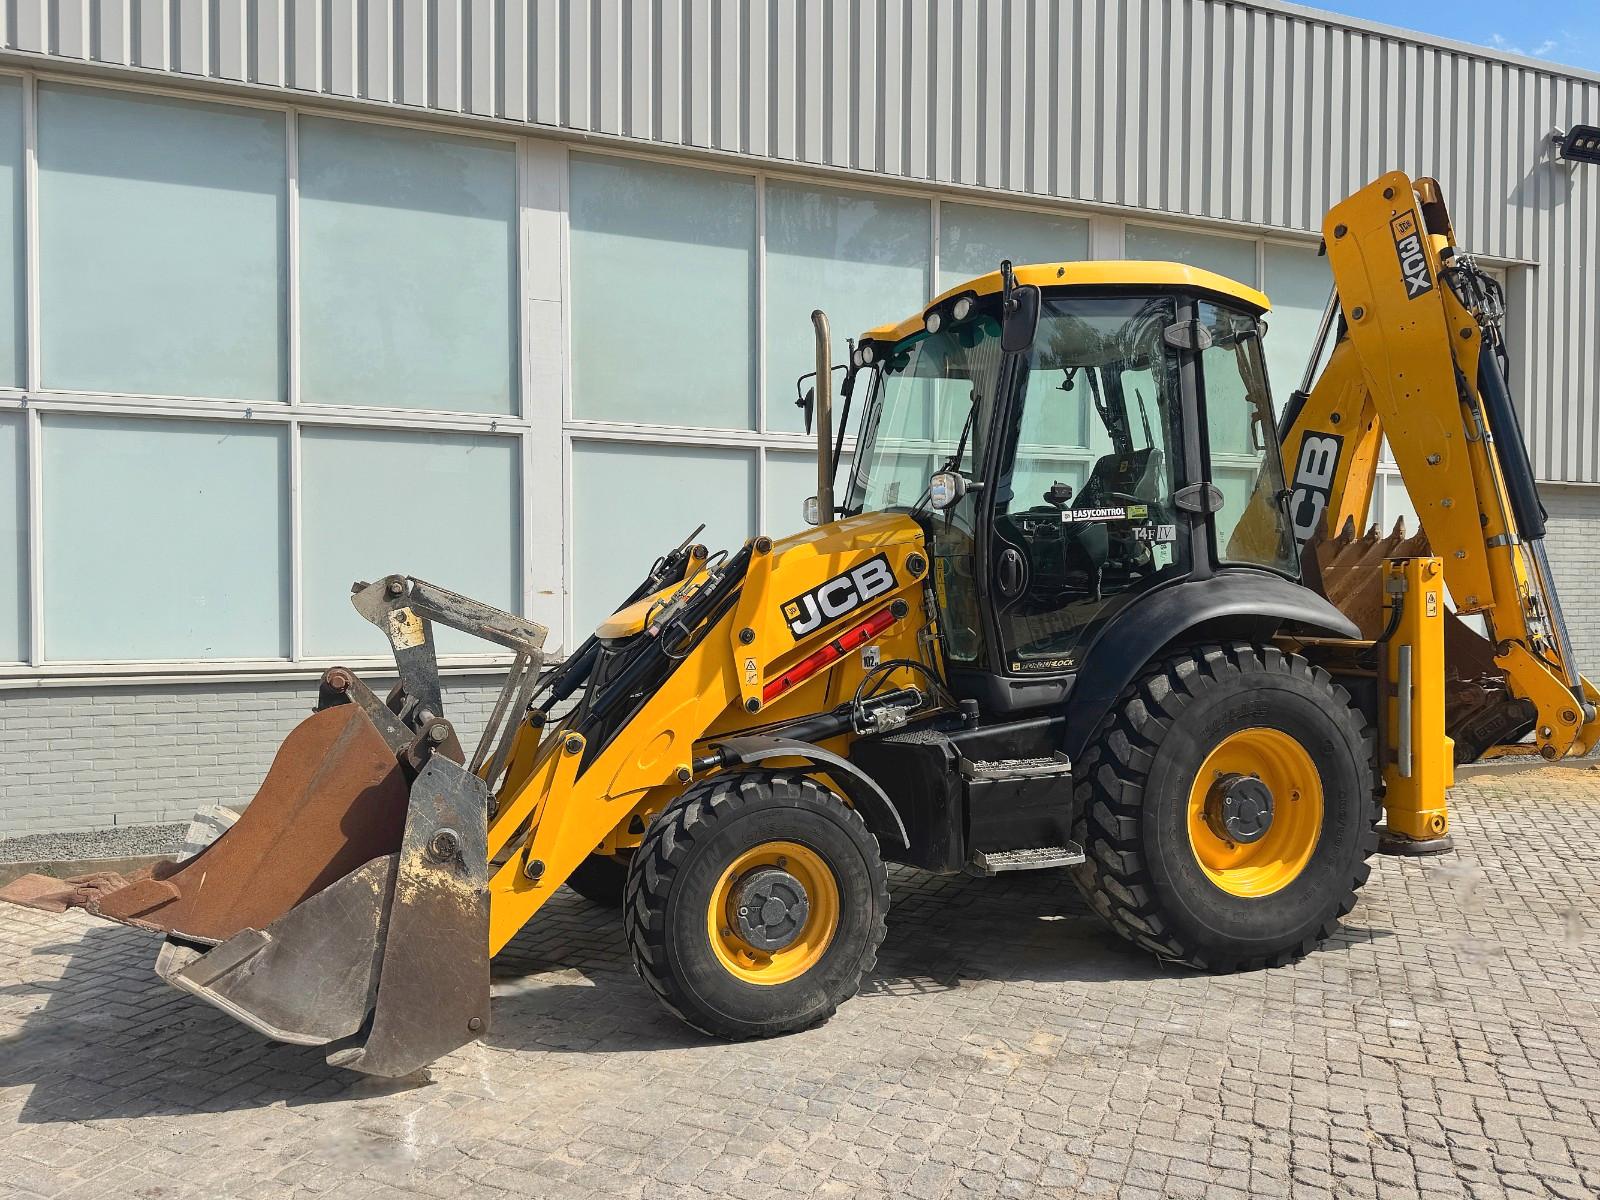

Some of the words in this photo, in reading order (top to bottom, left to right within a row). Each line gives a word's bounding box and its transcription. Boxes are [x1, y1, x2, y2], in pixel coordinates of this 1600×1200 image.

[1399, 235, 1431, 295] 3CX
[1073, 507, 1126, 519] EASYCONTROL
[790, 559, 894, 636] JCB
